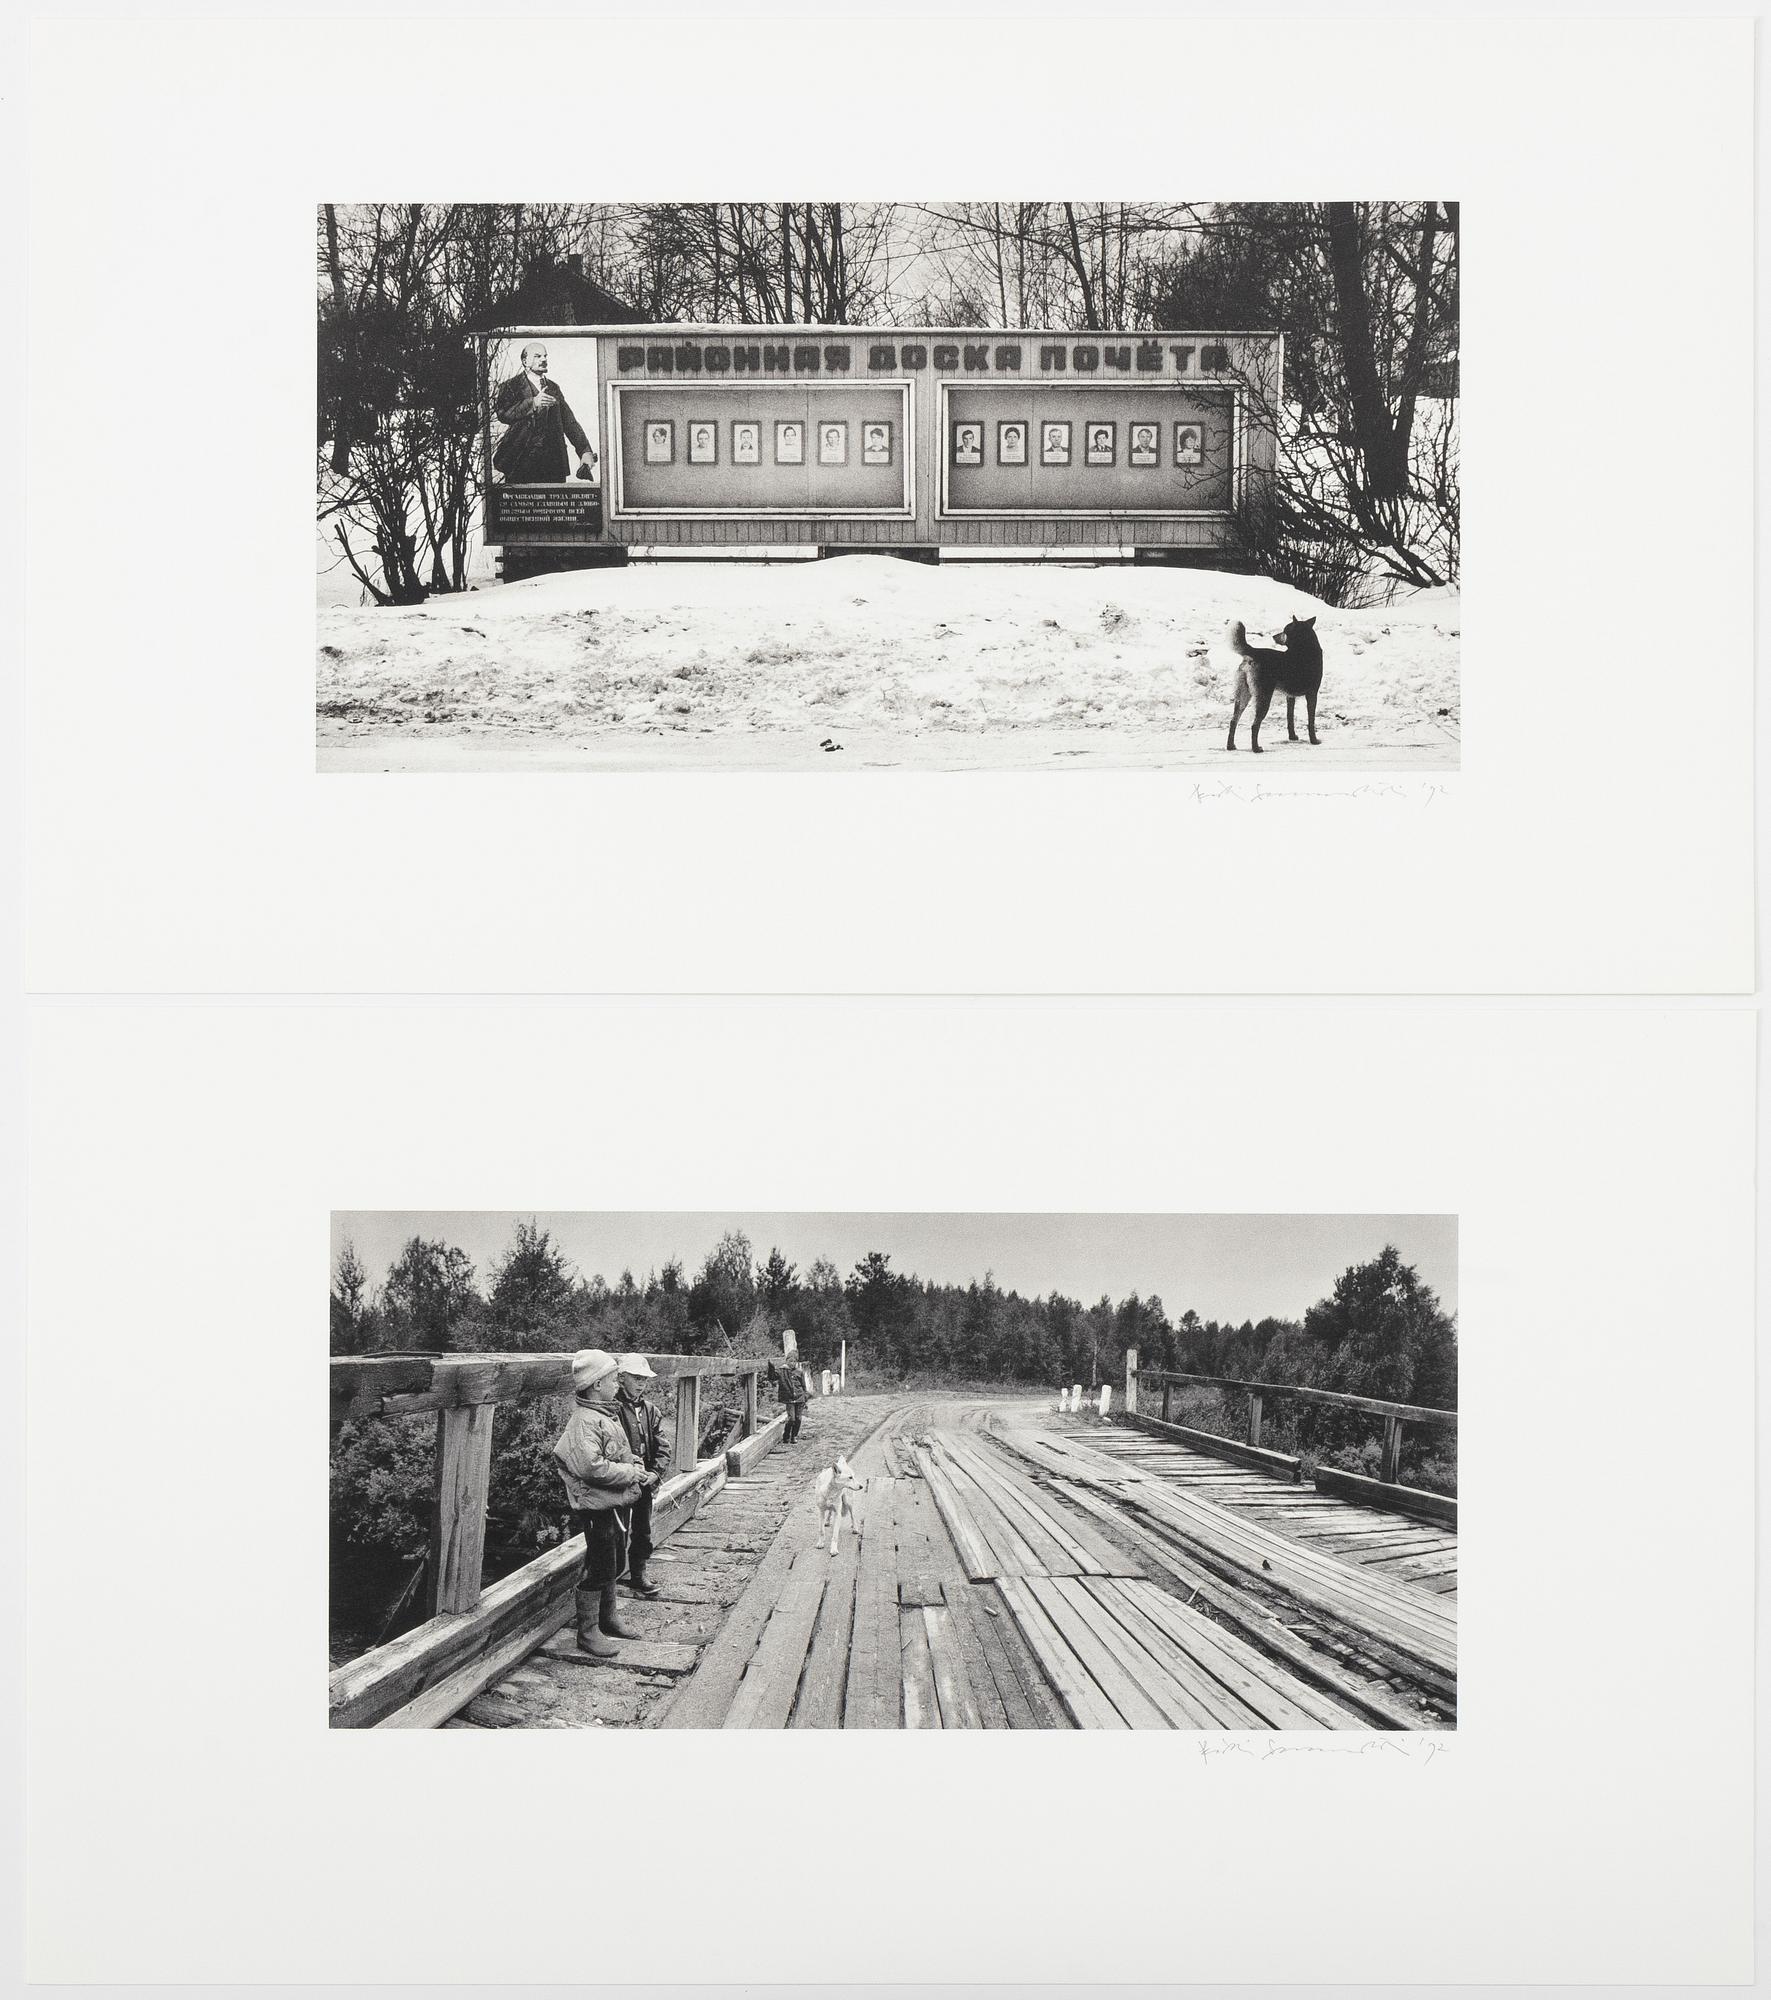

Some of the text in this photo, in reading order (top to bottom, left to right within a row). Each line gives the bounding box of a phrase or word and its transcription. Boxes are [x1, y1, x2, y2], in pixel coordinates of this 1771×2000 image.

[618, 339, 1228, 372] РАЙОННАЯ ДОСКА ПОЧЁТА
